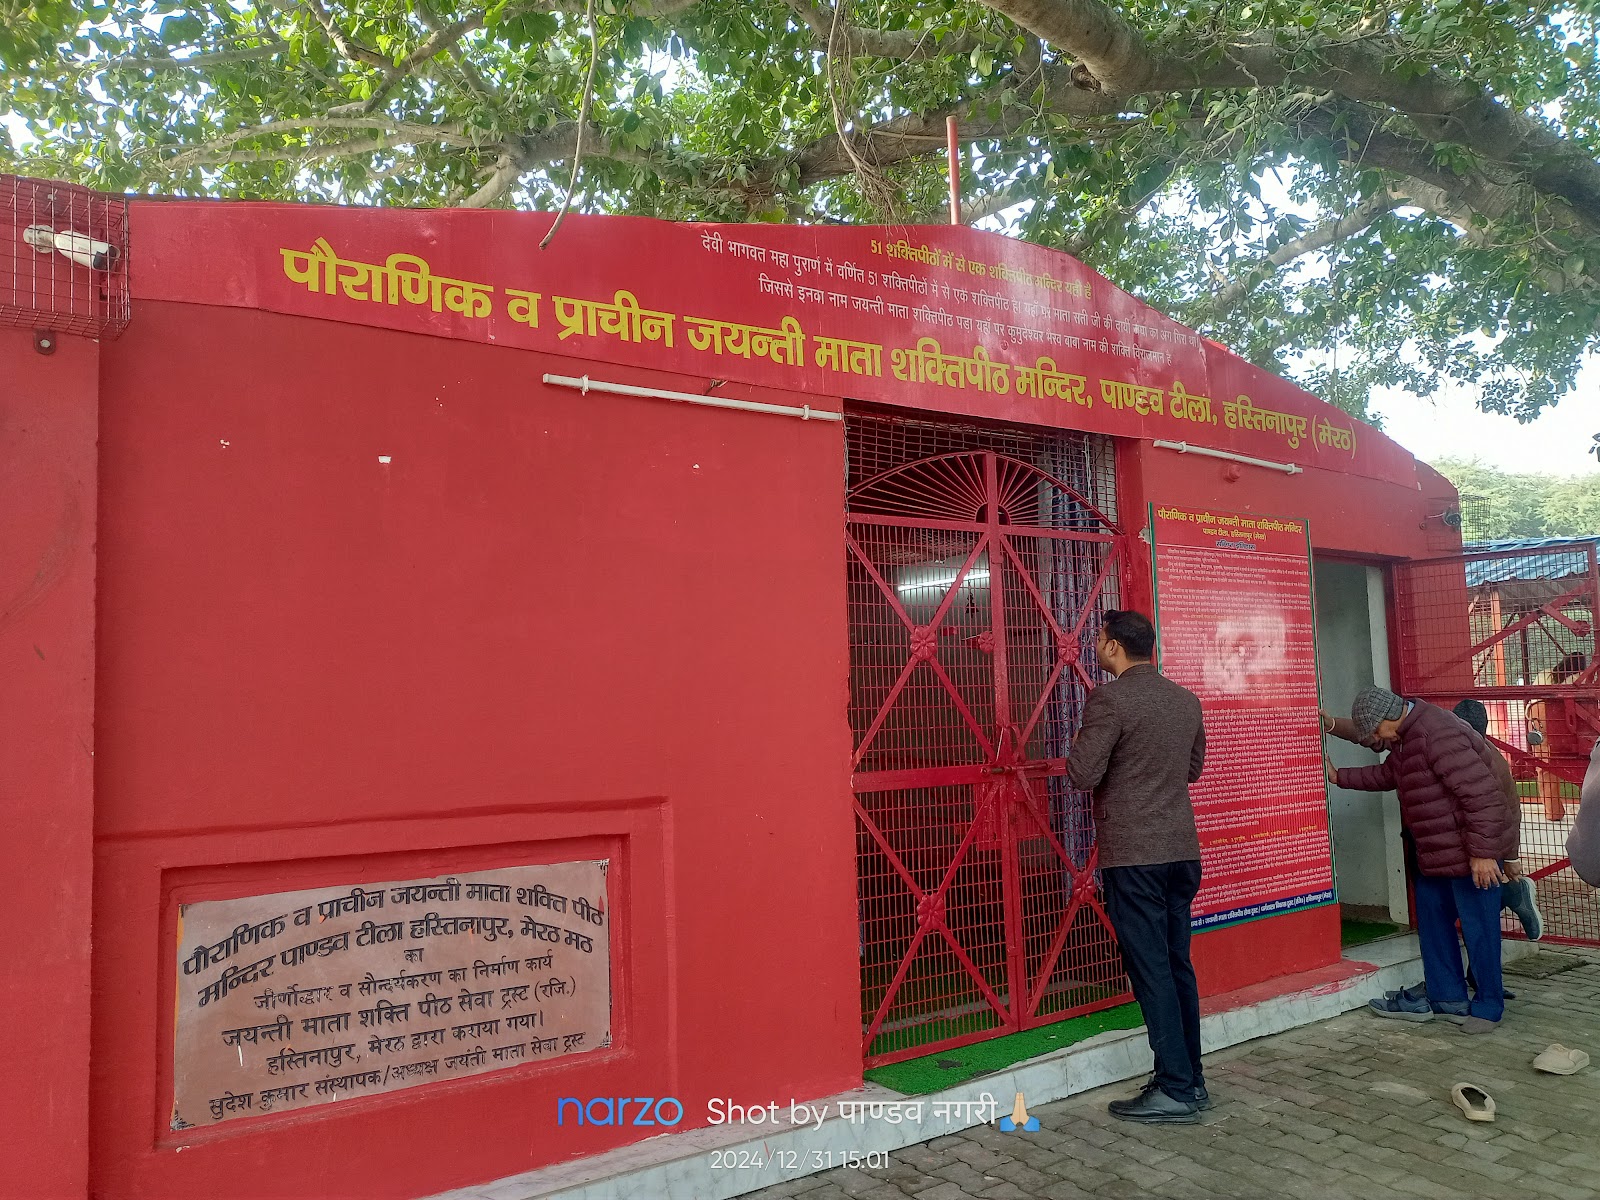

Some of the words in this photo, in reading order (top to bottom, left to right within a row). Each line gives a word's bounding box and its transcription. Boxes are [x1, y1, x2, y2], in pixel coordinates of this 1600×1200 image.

[701, 230, 723, 254] देवी
[728, 240, 766, 263] भागवत
[770, 250, 789, 268] महा
[824, 258, 834, 277] में
[836, 262, 864, 284] वर्णित
[868, 271, 878, 286] 51
[881, 270, 928, 296] शक्तिपीठों
[931, 279, 939, 298] में
[941, 282, 950, 300] से
[953, 288, 968, 304] एक
[1040, 304, 1050, 318] पर
[1053, 308, 1070, 322] माता
[1073, 308, 1088, 326] सती
[1091, 311, 1100, 328] जी
[1103, 314, 1112, 330] की
[870, 240, 882, 254] 51
[942, 251, 954, 269] में
[955, 254, 966, 272] से
[968, 260, 986, 276] एक
[280, 236, 494, 318] पौराणिक
[505, 288, 541, 328] व
[552, 290, 676, 348] प्राचीन
[684, 316, 805, 366] जयन्ती
[813, 334, 882, 377] माता
[891, 337, 1010, 394] शक्तिपीठ
[1014, 356, 1094, 409] मन्दिर,
[1168, 380, 1218, 426] टीला,
[1222, 394, 1308, 450] हस्तिनापुर
[1311, 413, 1358, 460] (मेरठ)
[758, 272, 794, 299] जिससे
[797, 284, 824, 305] इनका
[828, 292, 848, 309] नाम
[851, 295, 884, 316] जयन्ती
[888, 302, 909, 320] माता
[912, 304, 954, 327] शक्तिपीठ
[993, 322, 1005, 336] पर
[1064, 335, 1080, 350] बाबा
[1082, 338, 1096, 352] नाम
[1098, 337, 1109, 354] की
[1111, 340, 1130, 358] शक्ति
[182, 914, 288, 976] पौराणिक
[293, 906, 312, 926] व
[318, 888, 386, 923] प्राचीन
[391, 877, 462, 905] जयन्ती
[466, 883, 511, 903] माता
[516, 884, 568, 914] शक्ति
[572, 896, 604, 926] पीठ
[198, 954, 277, 1008] मन्दिर
[280, 932, 350, 967] पाण्डव
[354, 920, 404, 947] टीला
[410, 912, 514, 942] हस्तिनापुर,
[520, 916, 561, 944] मेरठ
[564, 929, 594, 954] मठ
[404, 948, 424, 964] का
[222, 1014, 294, 1047] जयन्ती
[301, 1012, 351, 1036] माता
[358, 1000, 411, 1028] शक्ति
[418, 992, 452, 1018] पीठ
[458, 988, 494, 1012] सेवा
[500, 984, 530, 1010] ट्रस्ट
[534, 976, 576, 1003] (रजि.)
[338, 984, 352, 998] व
[448, 967, 468, 983] का
[472, 956, 520, 980] निर्माण
[524, 950, 553, 971] कार्य
[209, 1090, 254, 1120] सुदेश
[260, 1082, 310, 1111] कुमार
[444, 1045, 486, 1070] जयंती
[492, 1043, 526, 1062] माता
[531, 1036, 558, 1056] सेवा
[563, 1032, 586, 1053] ट्रस्ट
[266, 1043, 361, 1076] हस्तिनापुर,
[368, 1034, 406, 1055] मेरठ
[411, 1028, 446, 1050] द्वारा
[452, 1019, 500, 1042] कराया
[506, 1010, 544, 1031] गया।
